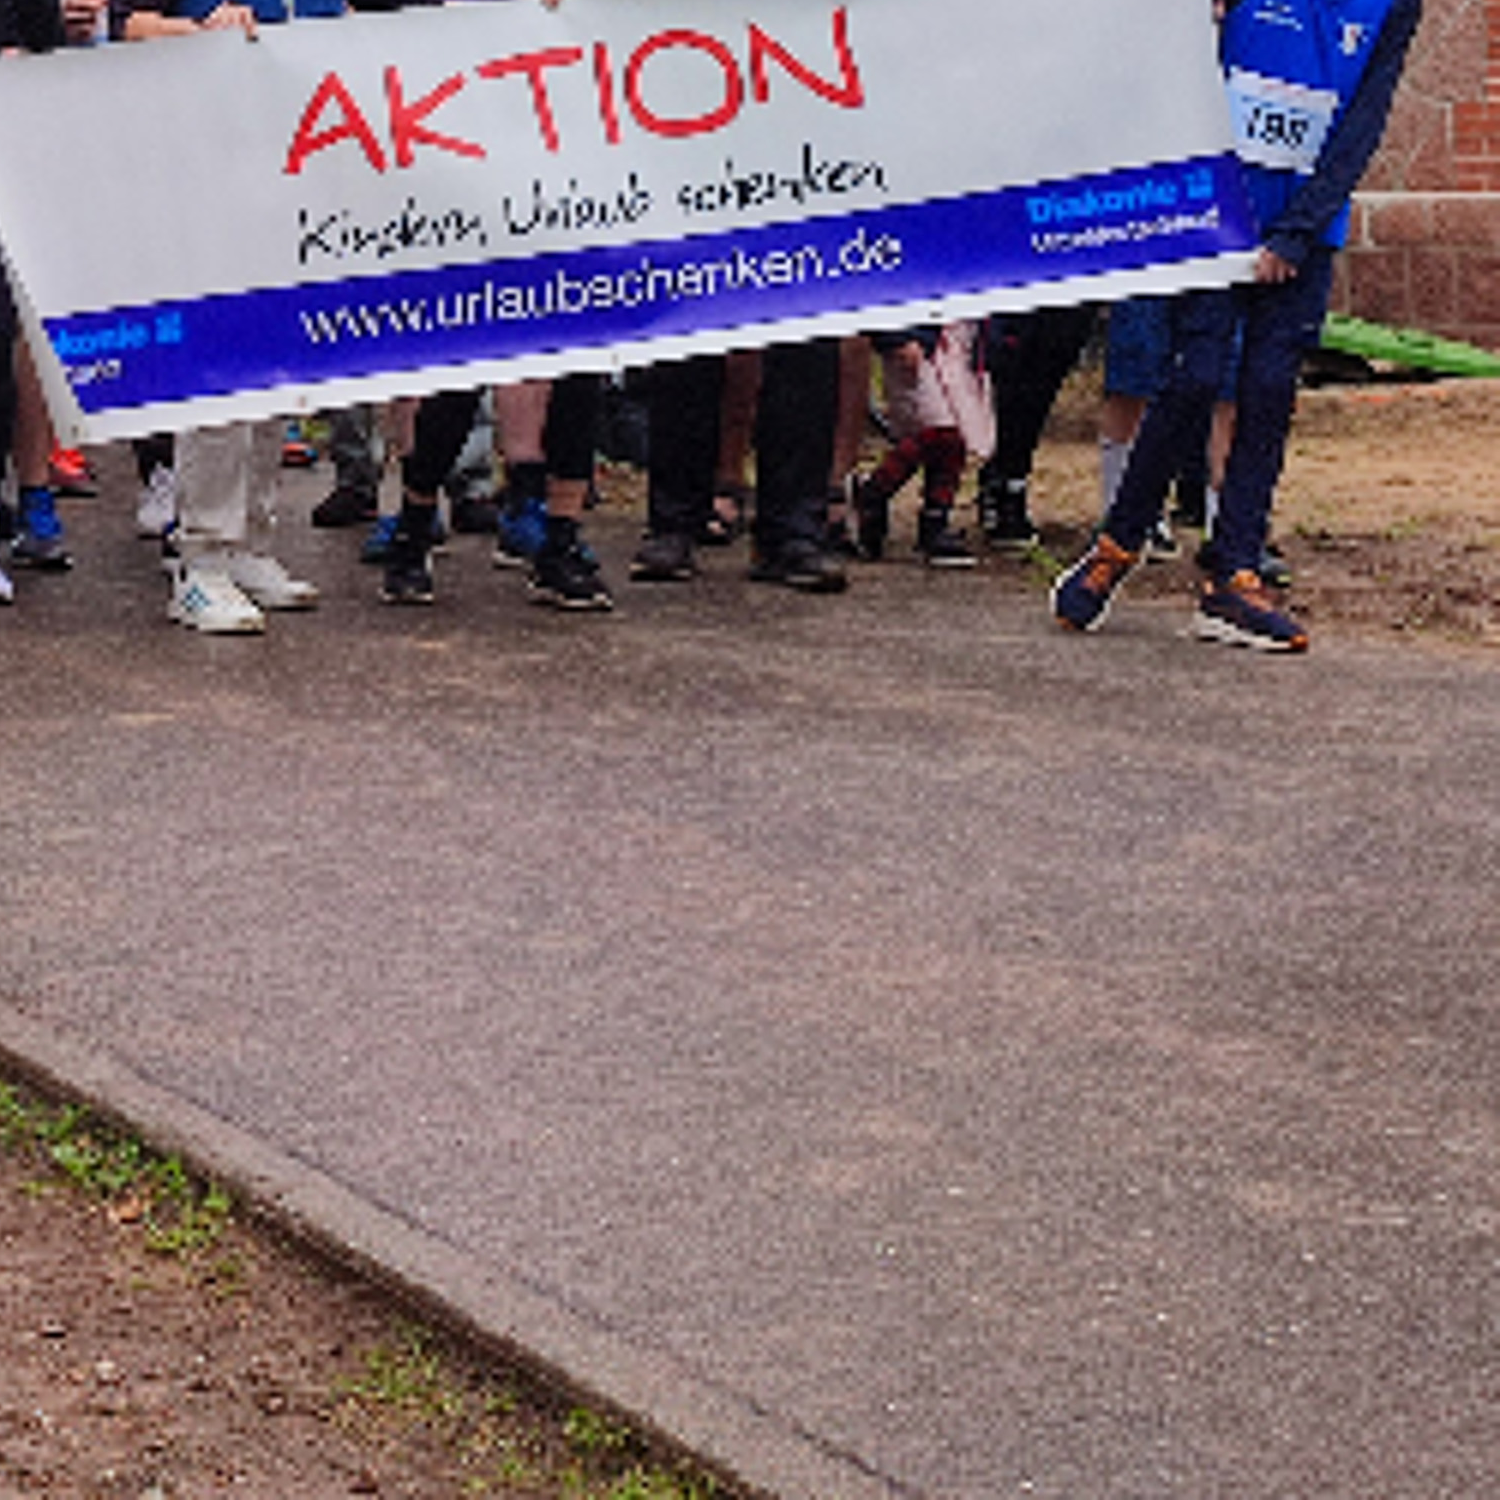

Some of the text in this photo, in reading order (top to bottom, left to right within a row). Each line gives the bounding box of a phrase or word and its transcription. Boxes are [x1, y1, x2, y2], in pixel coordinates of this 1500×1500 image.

[282, 6, 864, 175] AKTION
[502, 173, 654, 236] Urlaub
[677, 143, 890, 213] schenken
[1025, 180, 1178, 223] Diakonie
[300, 228, 903, 343] www.urlaubschenken.de
